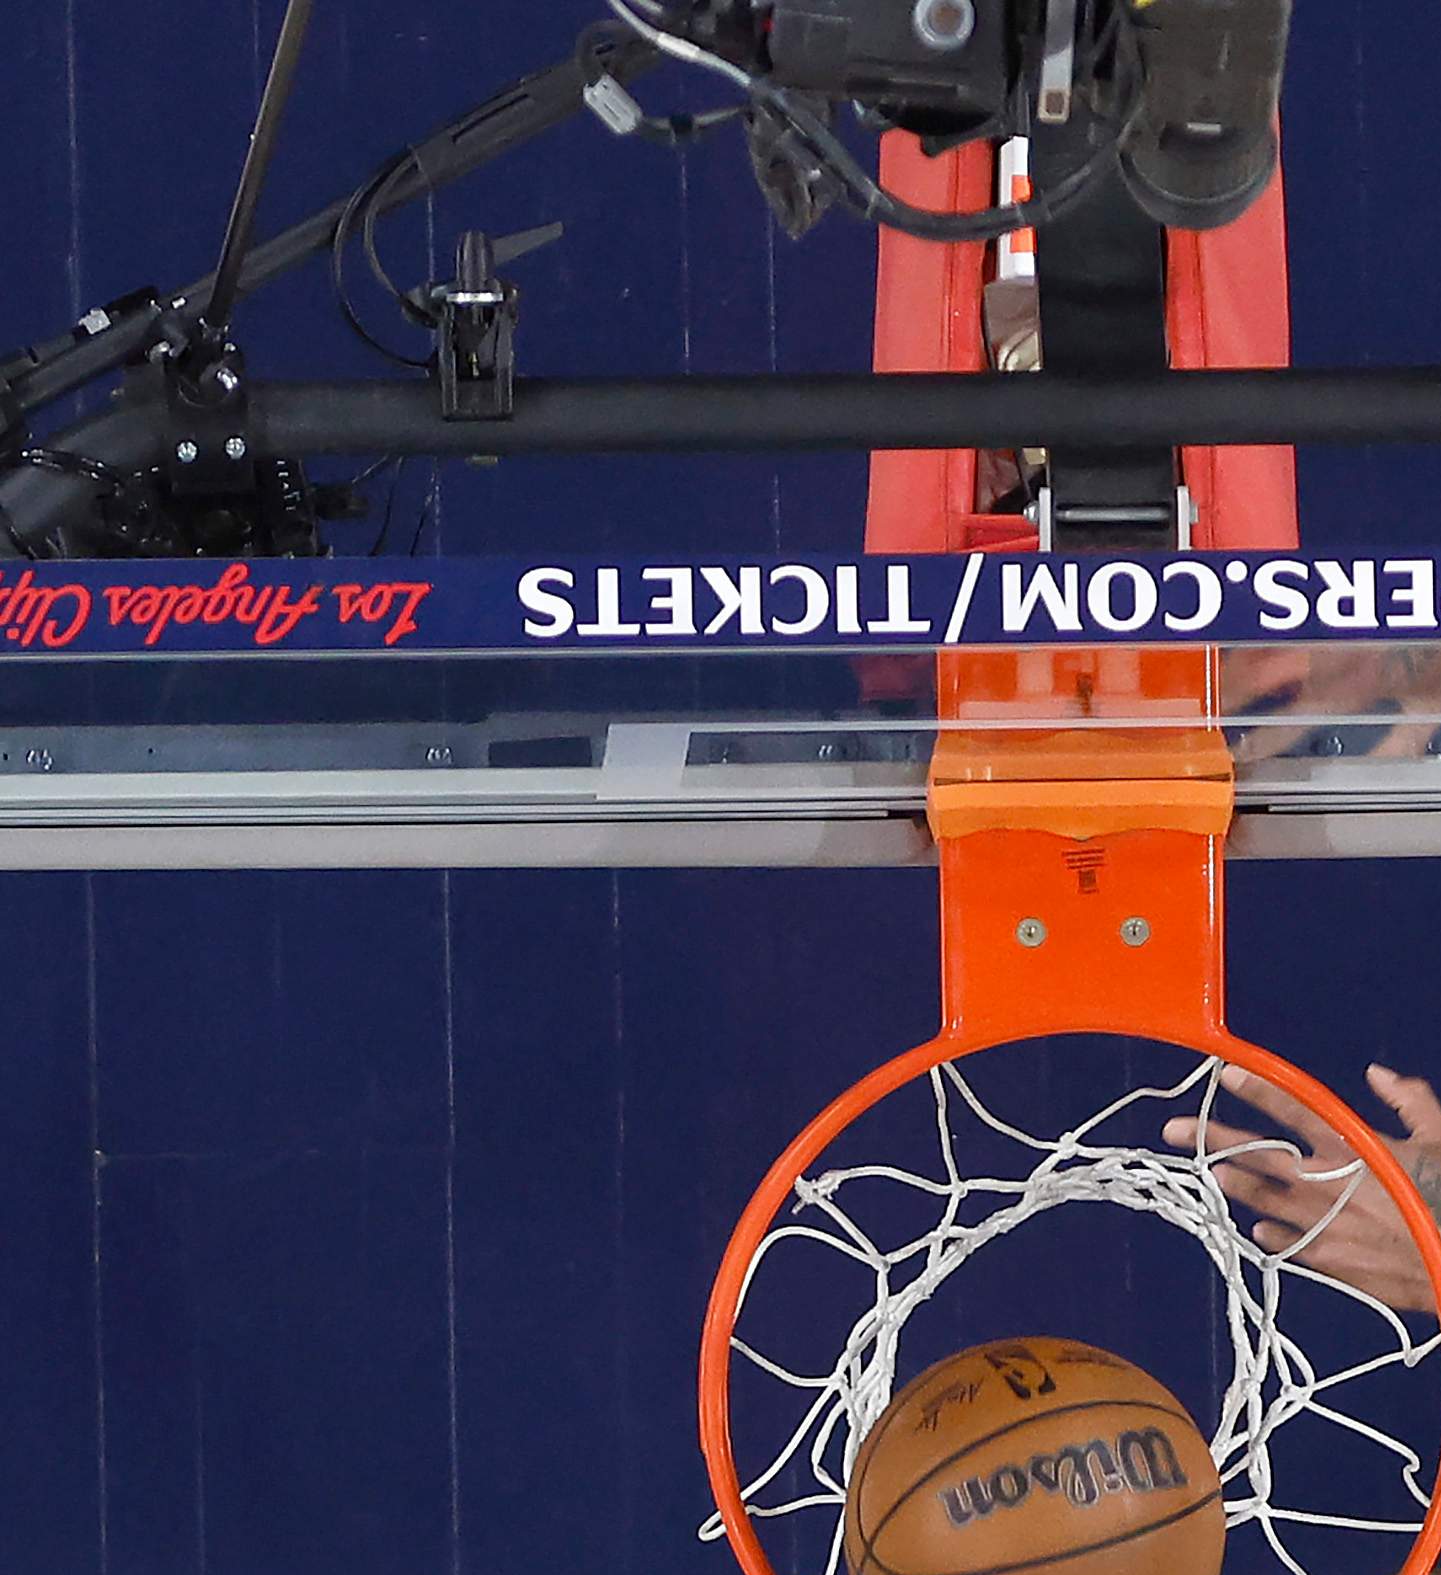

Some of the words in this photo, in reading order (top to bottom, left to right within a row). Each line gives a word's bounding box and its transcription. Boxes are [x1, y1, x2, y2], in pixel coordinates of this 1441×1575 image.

[0, 570, 91, 647] Clip
[103, 562, 320, 645] Angeles
[332, 581, 431, 645] Los
[937, 1426, 1190, 1528] Wilson
